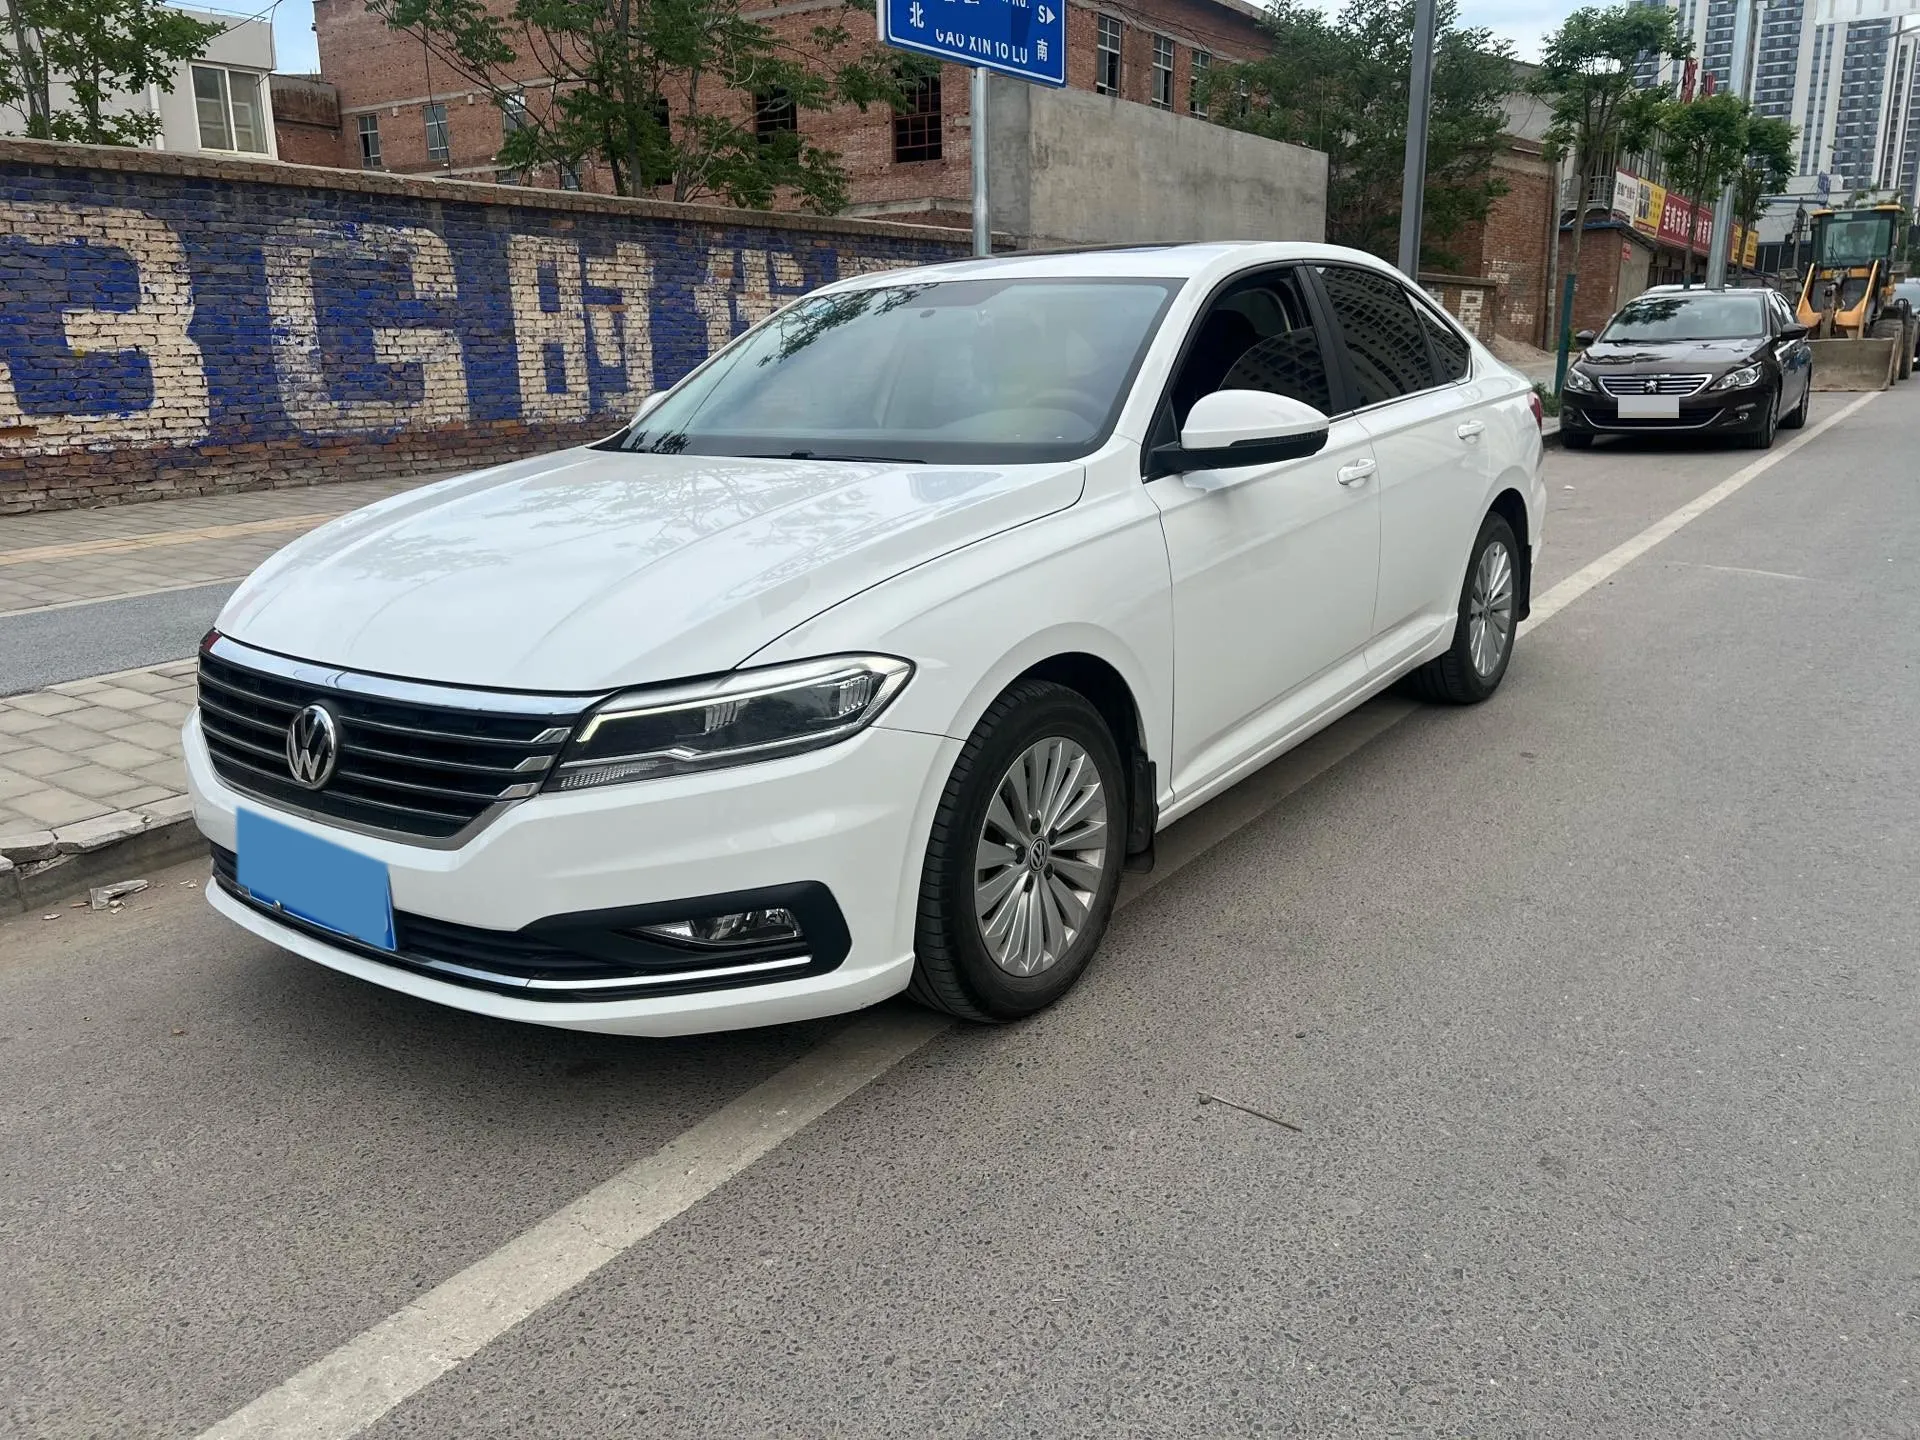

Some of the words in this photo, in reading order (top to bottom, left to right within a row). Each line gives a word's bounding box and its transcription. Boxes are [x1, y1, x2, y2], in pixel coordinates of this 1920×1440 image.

[909, 2, 925, 28] 北
[1037, 5, 1046, 24] S
[936, 28, 965, 48] GAO
[969, 36, 991, 56] XIN
[995, 41, 1009, 60] 10
[1012, 45, 1028, 65] LU
[1036, 38, 1049, 62] 南
